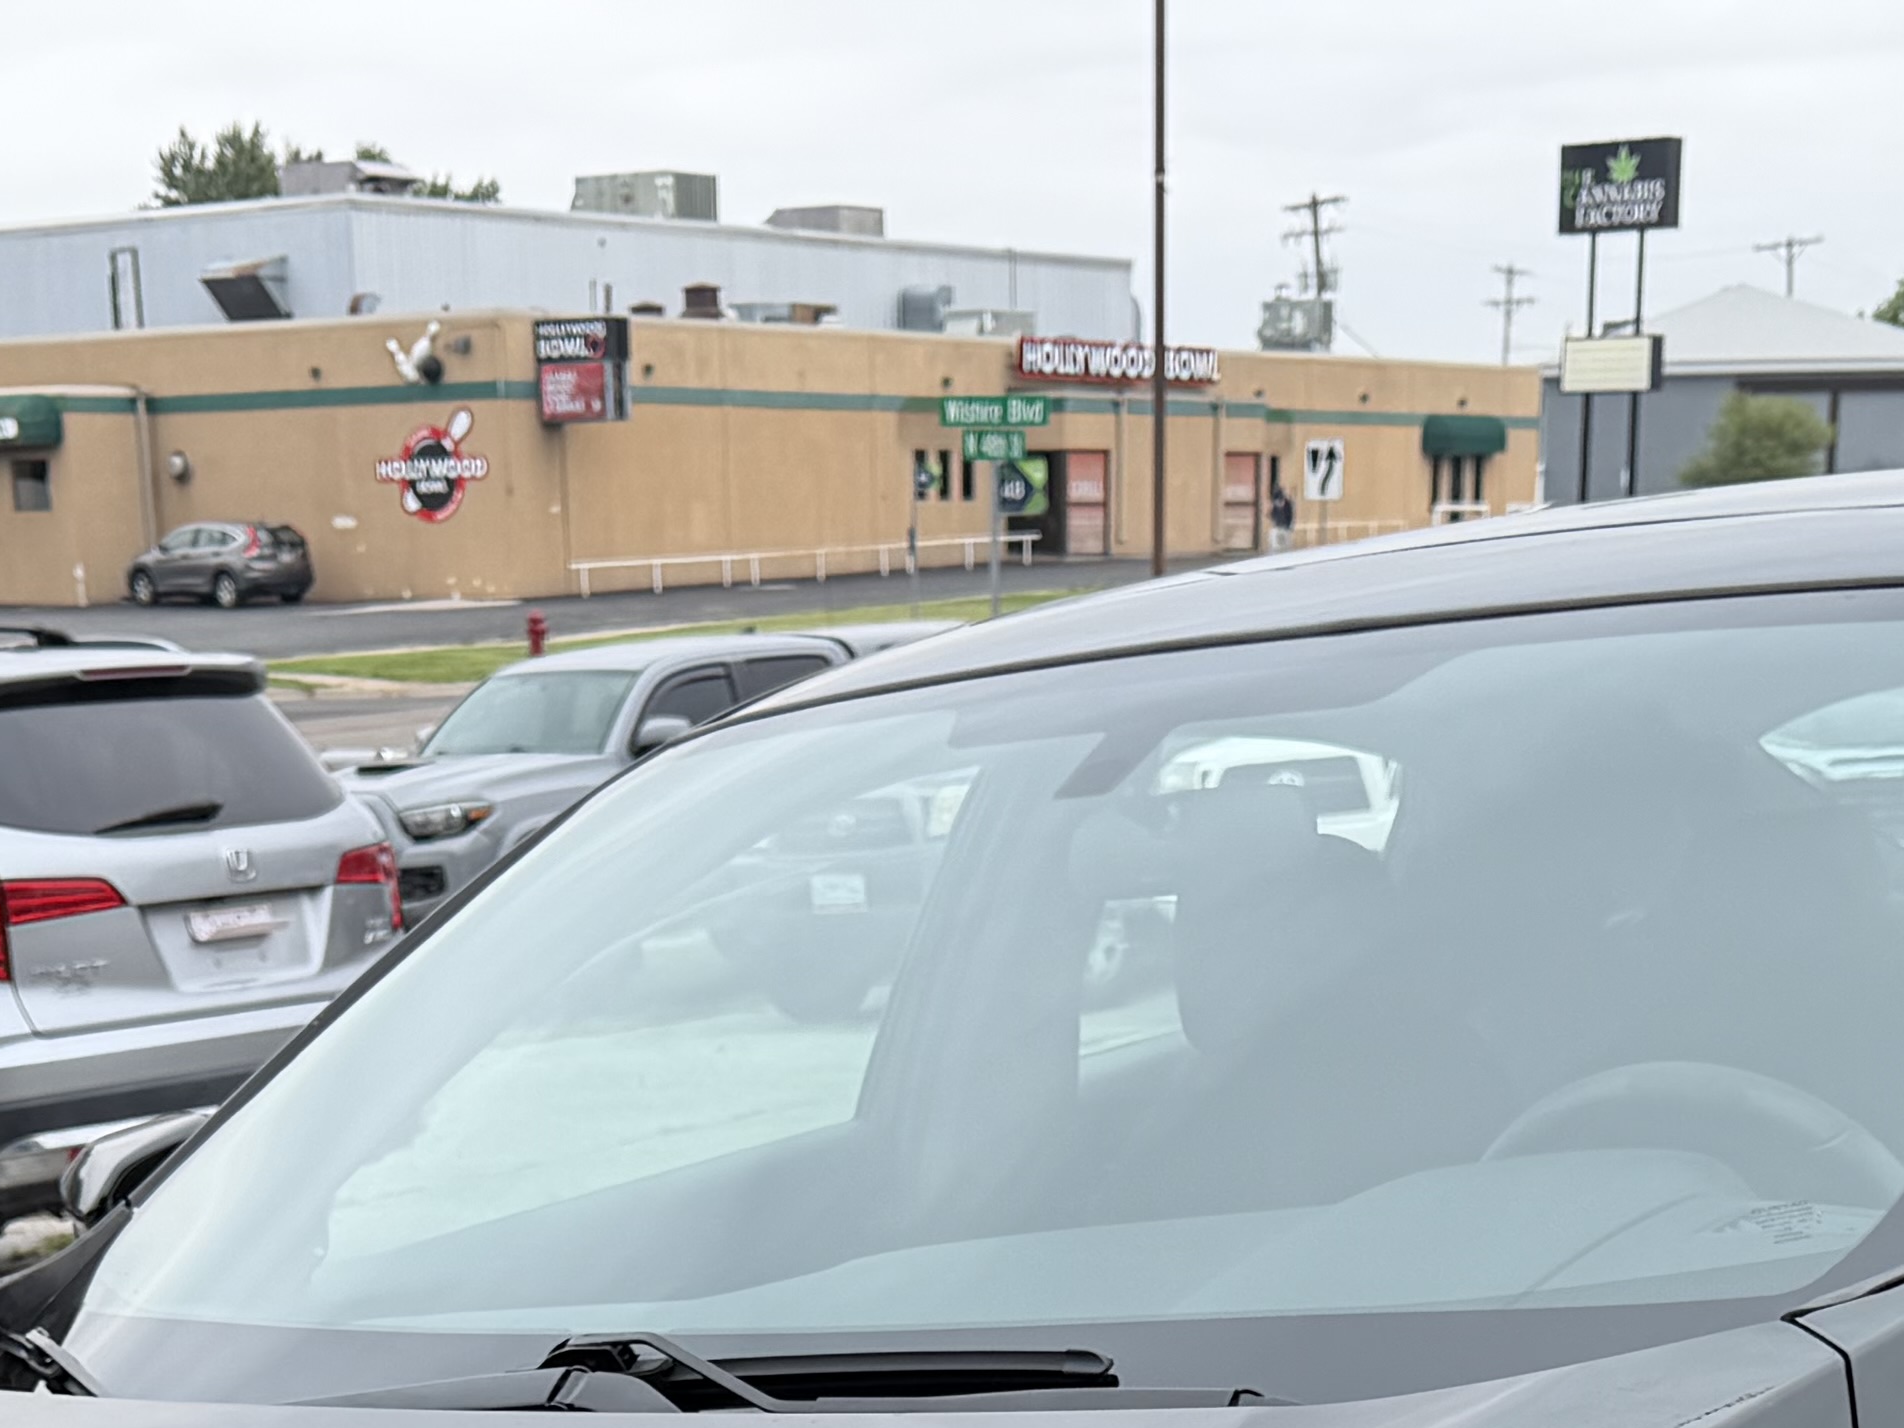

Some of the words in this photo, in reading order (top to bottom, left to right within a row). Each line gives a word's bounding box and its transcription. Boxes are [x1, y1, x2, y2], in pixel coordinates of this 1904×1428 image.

[1022, 340, 1156, 379] HOLLYWOOD
[945, 400, 1003, 423] Wilshire
[1007, 399, 1044, 422] Blvd
[376, 457, 487, 481] HOLLYWOOD
